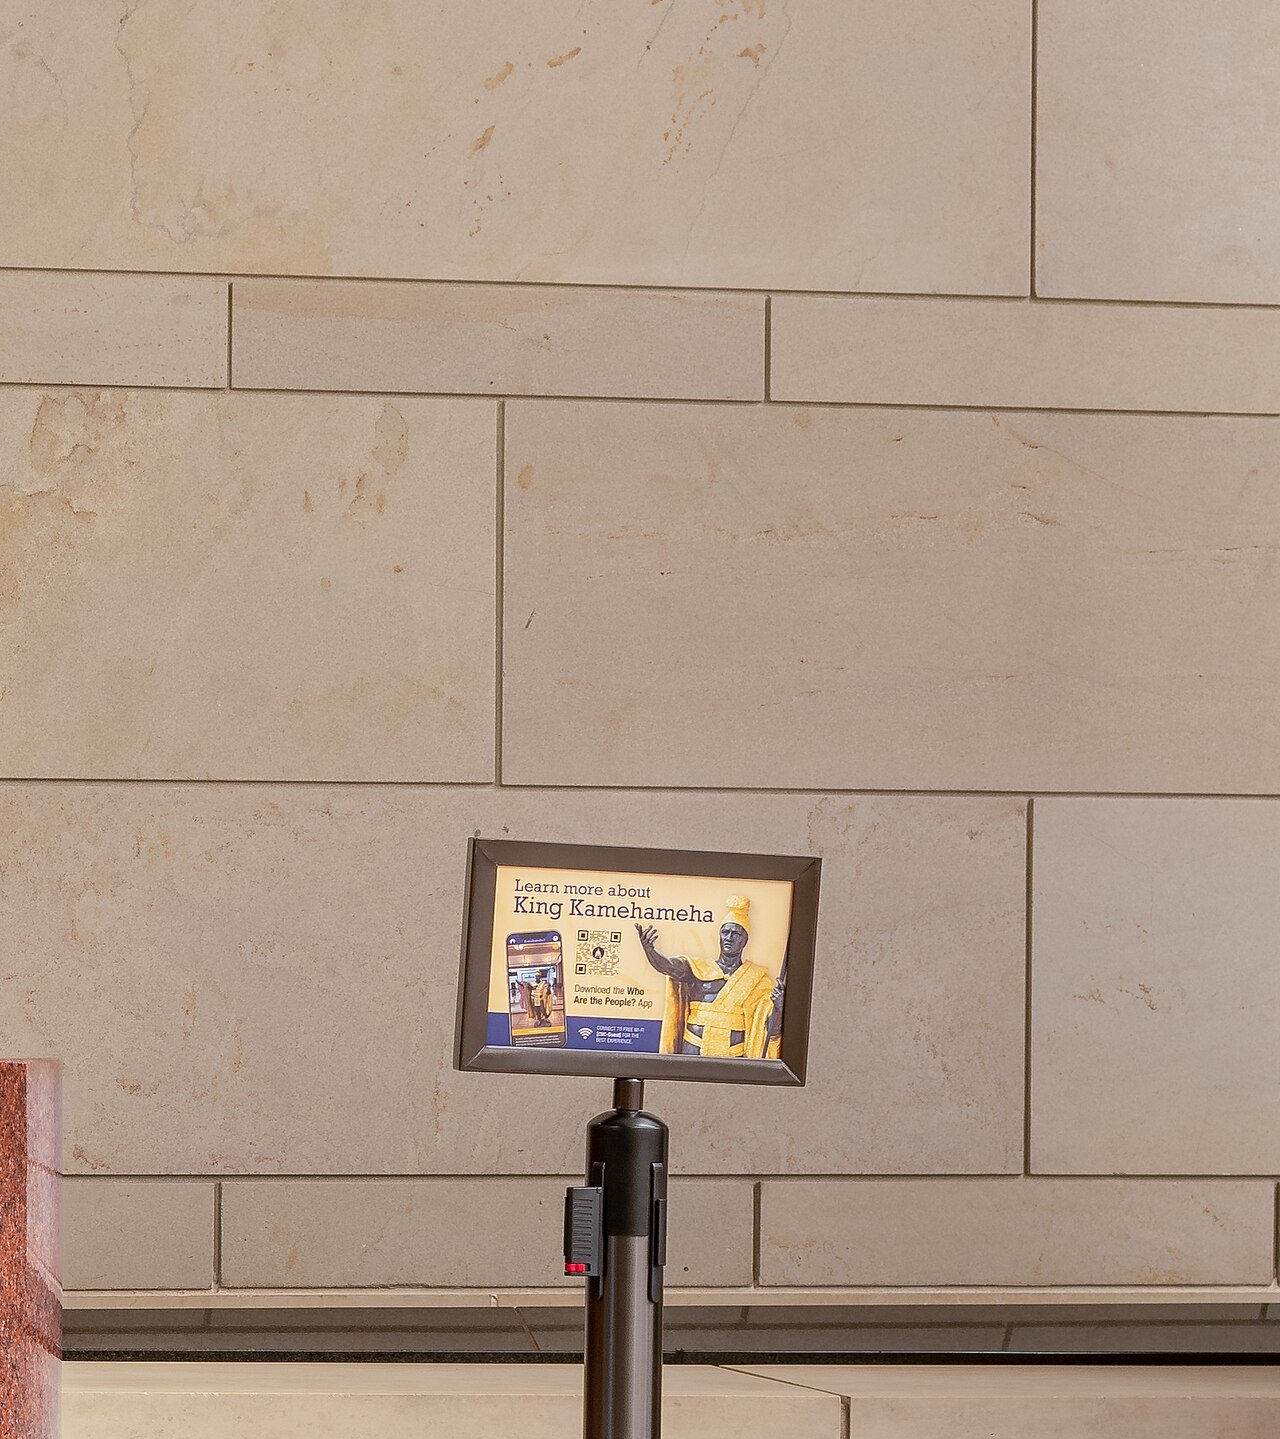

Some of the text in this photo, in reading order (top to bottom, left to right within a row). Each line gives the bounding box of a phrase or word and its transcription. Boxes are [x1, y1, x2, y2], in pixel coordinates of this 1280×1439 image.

[514, 879, 651, 898] Learn more about
[513, 896, 714, 923] King Kamehameha
[574, 984, 645, 996] Download the Who
[573, 996, 653, 1009] Are the People? App
